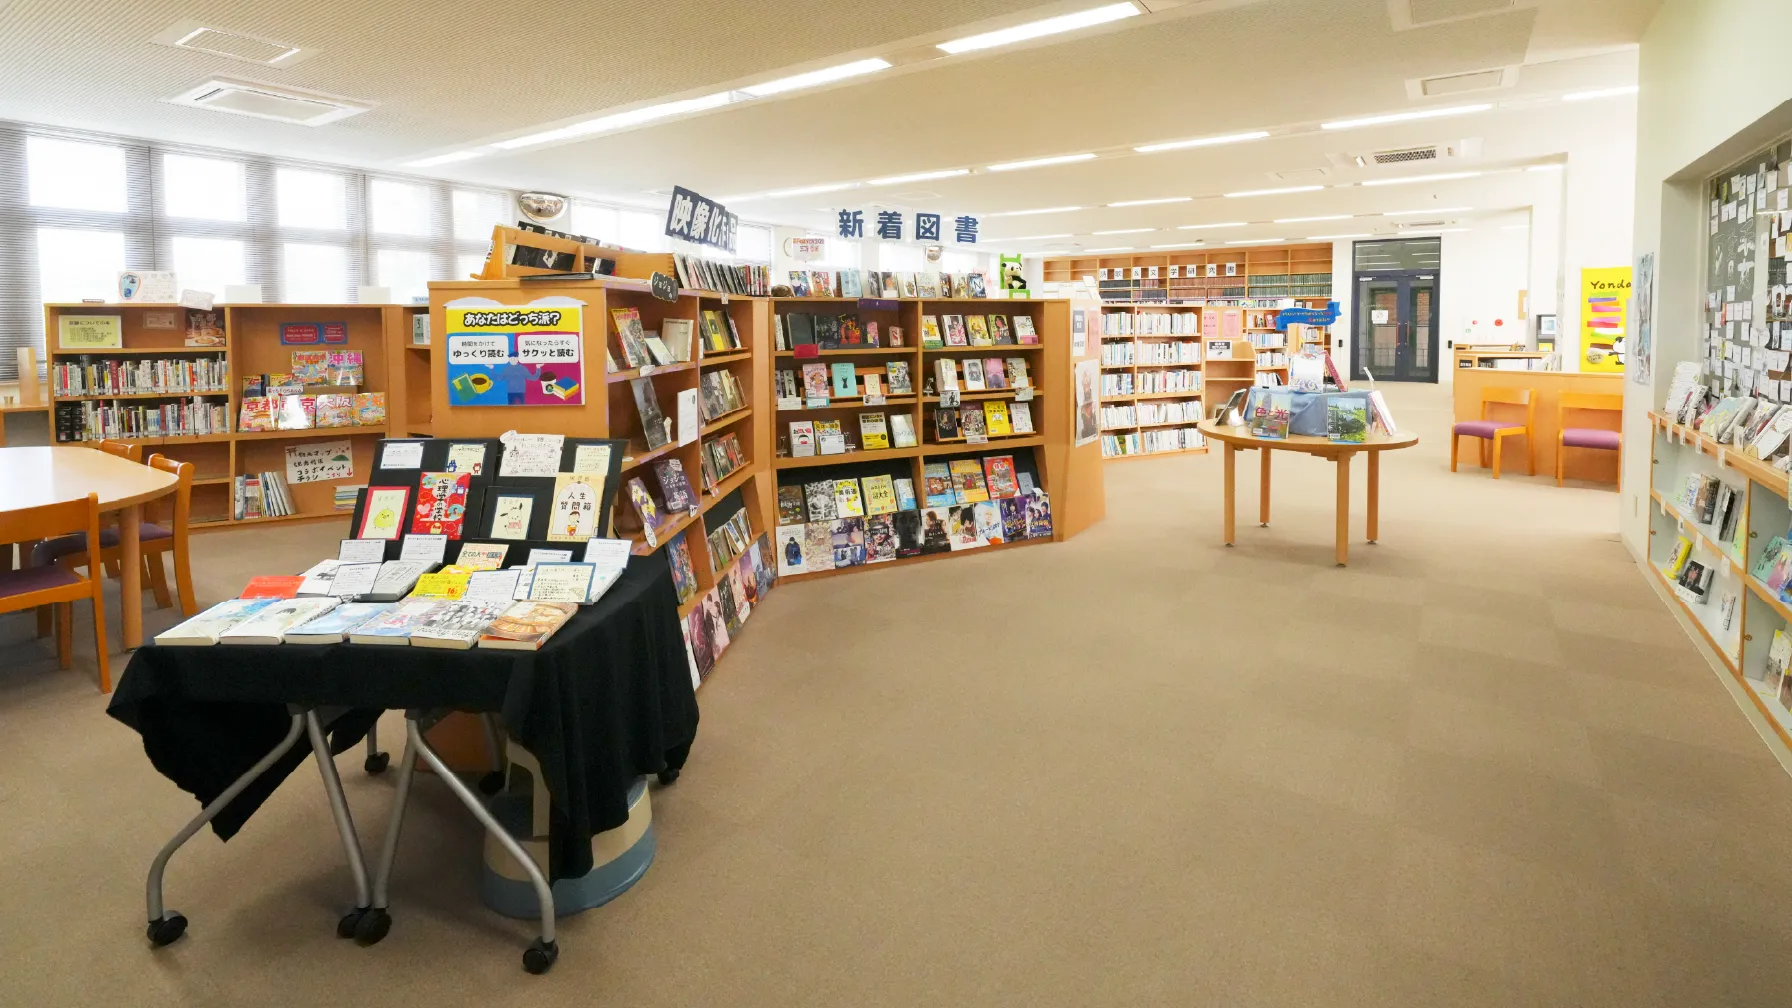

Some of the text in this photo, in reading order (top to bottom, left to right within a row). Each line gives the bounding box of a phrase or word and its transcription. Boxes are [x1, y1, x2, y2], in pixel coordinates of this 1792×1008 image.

[838, 208, 979, 243] 新着図書
[463, 311, 562, 327] あなたはどっち派?
[453, 349, 505, 358] ゆっくり読む
[522, 348, 575, 357] サクッと読む
[329, 353, 363, 365] 沖縄
[244, 398, 279, 411] 京都
[319, 396, 352, 408] 大阪
[433, 478, 450, 522] 心理学の学校
[568, 492, 586, 500] 人生
[560, 501, 592, 511] 質問箱
